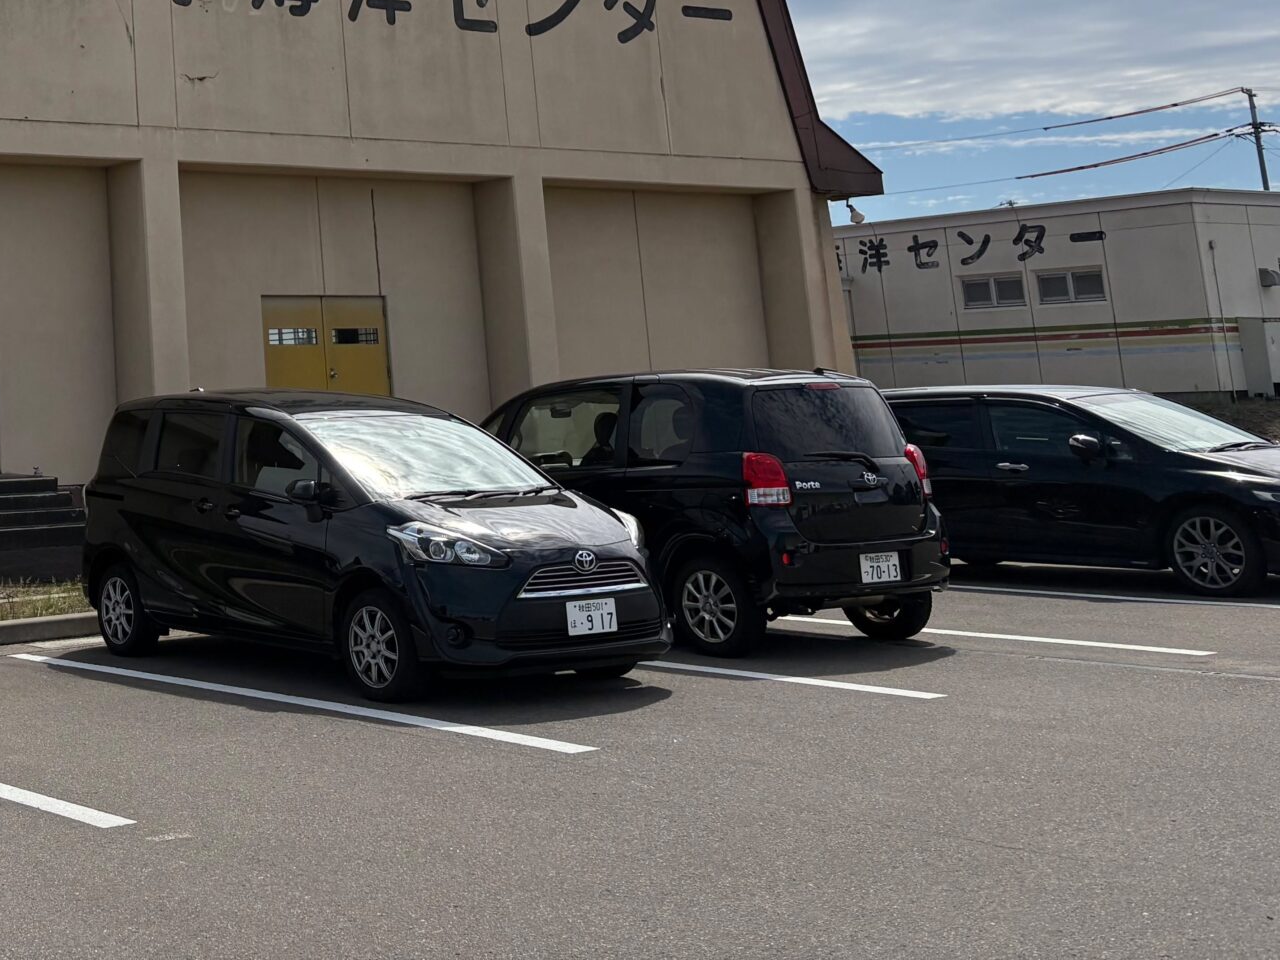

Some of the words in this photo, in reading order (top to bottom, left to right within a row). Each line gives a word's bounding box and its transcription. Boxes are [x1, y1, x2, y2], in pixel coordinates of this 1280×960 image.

[835, 223, 1106, 274] 洋センター
[795, 481, 821, 490] Porte
